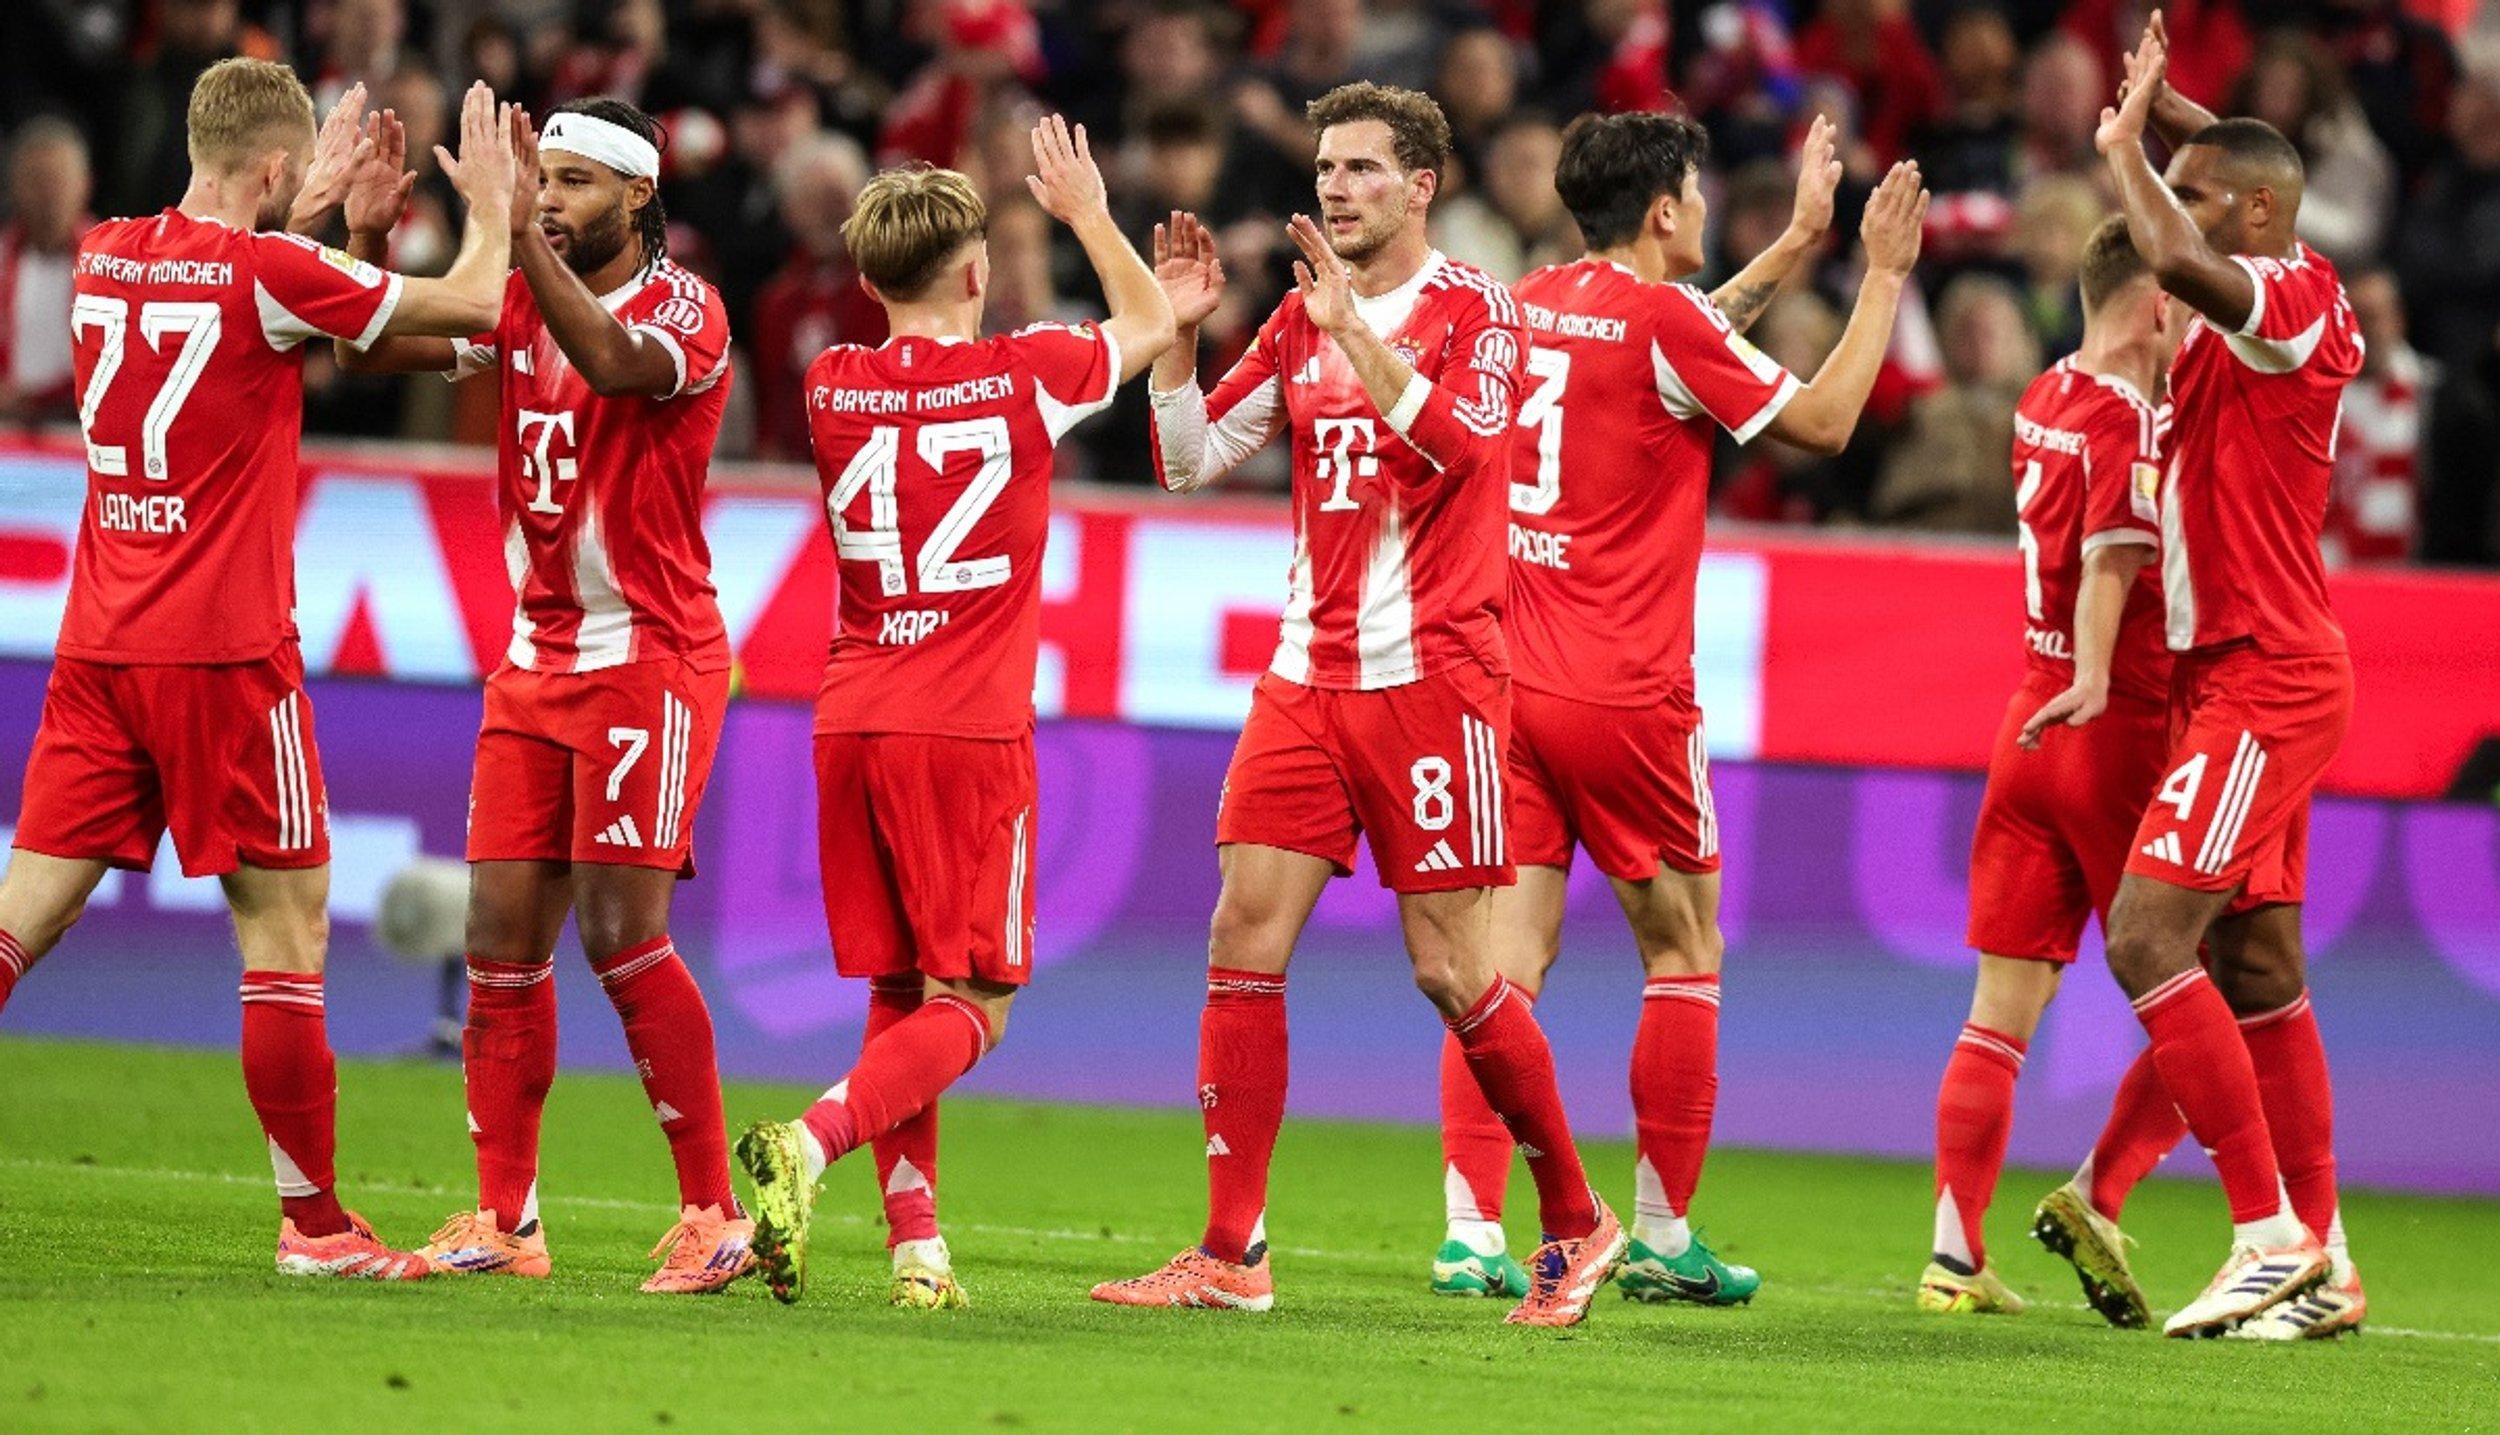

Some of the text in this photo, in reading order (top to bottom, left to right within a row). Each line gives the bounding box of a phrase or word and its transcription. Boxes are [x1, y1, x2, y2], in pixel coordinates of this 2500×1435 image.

[71, 293, 222, 481] 27
[832, 388, 909, 414] BAYERN
[1507, 346, 1571, 516] 3
[97, 491, 187, 534] LAIMER
[827, 415, 1012, 597] 42
[606, 727, 649, 801] 7
[1410, 756, 1454, 830] 8
[2157, 752, 2208, 821] 4
